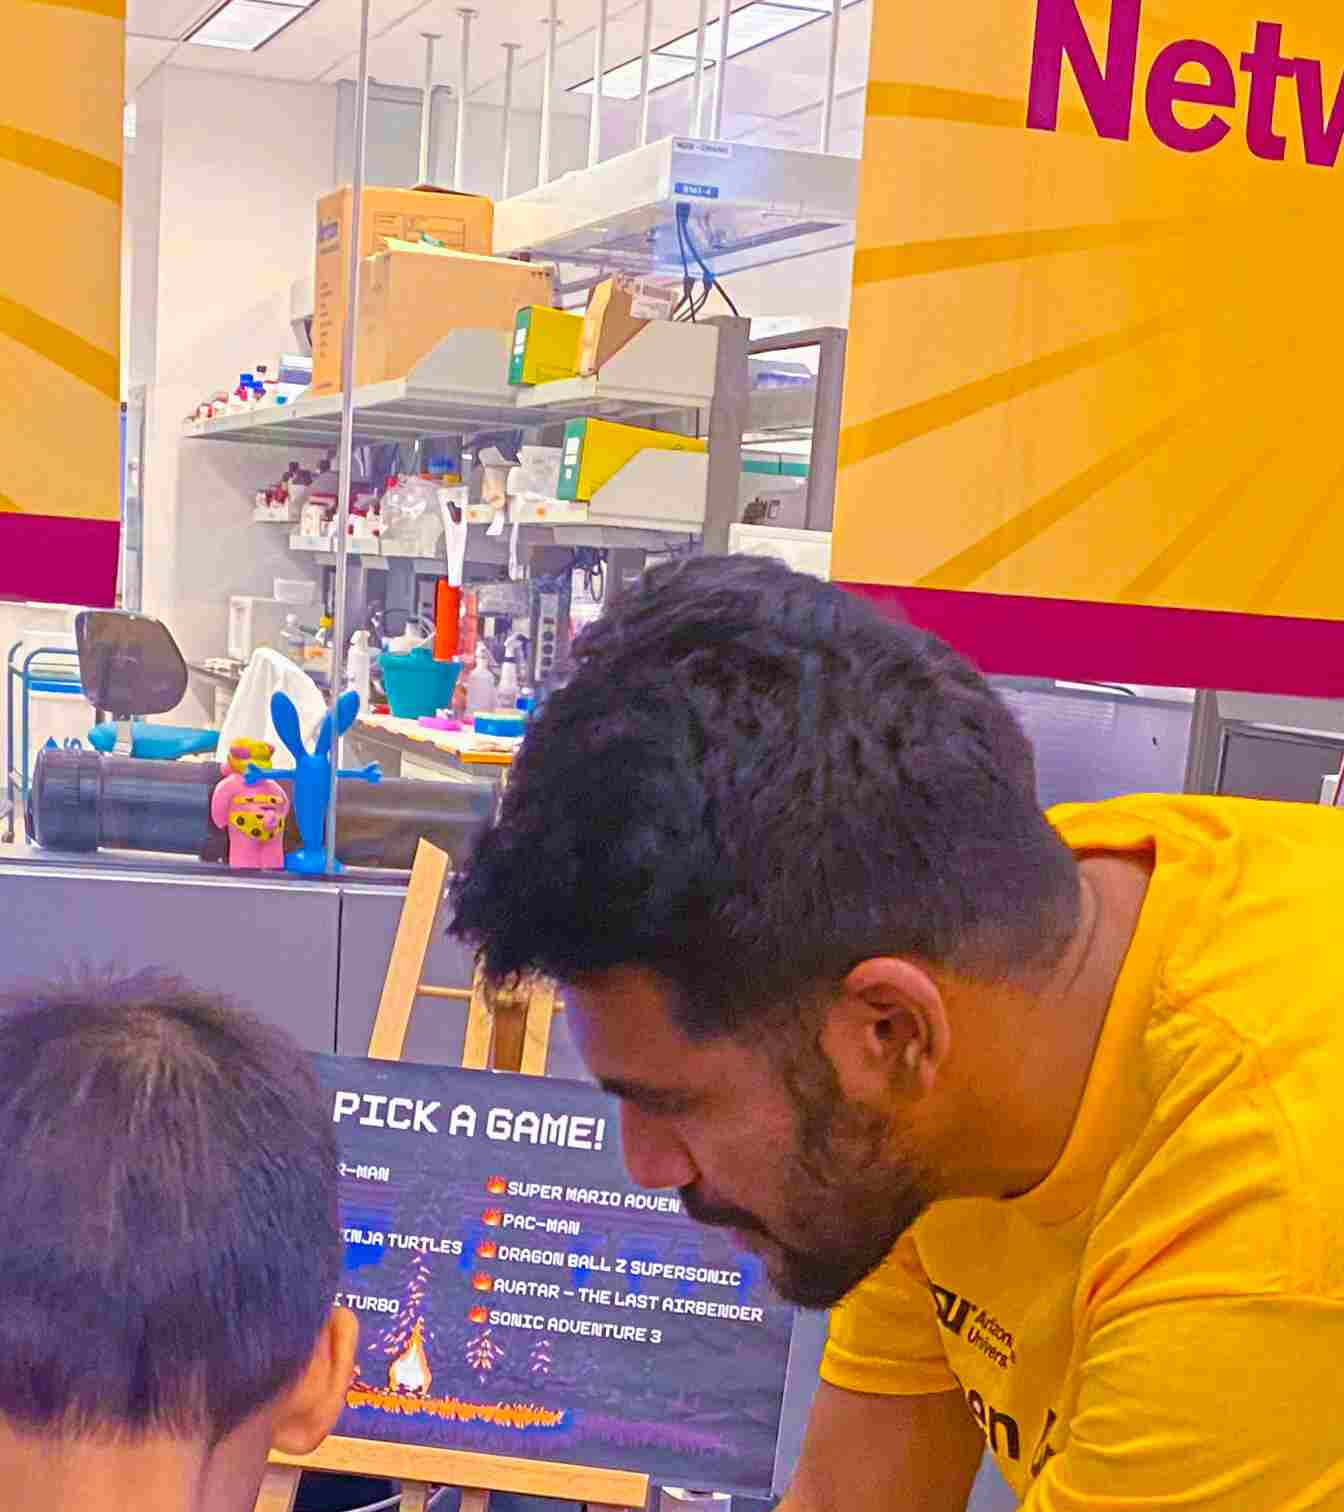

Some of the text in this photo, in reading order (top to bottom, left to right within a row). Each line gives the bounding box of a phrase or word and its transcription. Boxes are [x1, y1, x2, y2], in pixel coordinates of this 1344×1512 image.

[333, 1090, 606, 1151] PICK A GAME!
[507, 1181, 563, 1201] SUPER
[565, 1187, 621, 1207] MARIO
[503, 1213, 580, 1236] PAC-MAN
[387, 1233, 463, 1255] TURTLES
[498, 1247, 742, 1287] DRAGON BALL Z SUPERSONIC
[346, 1294, 400, 1313] TURBO
[493, 1277, 560, 1299] AVATAR
[578, 1287, 612, 1306] THE
[614, 1291, 659, 1311] LAST
[662, 1297, 763, 1323] AIRBENDER
[489, 1310, 662, 1344] SONIC ADVENTURE 3
